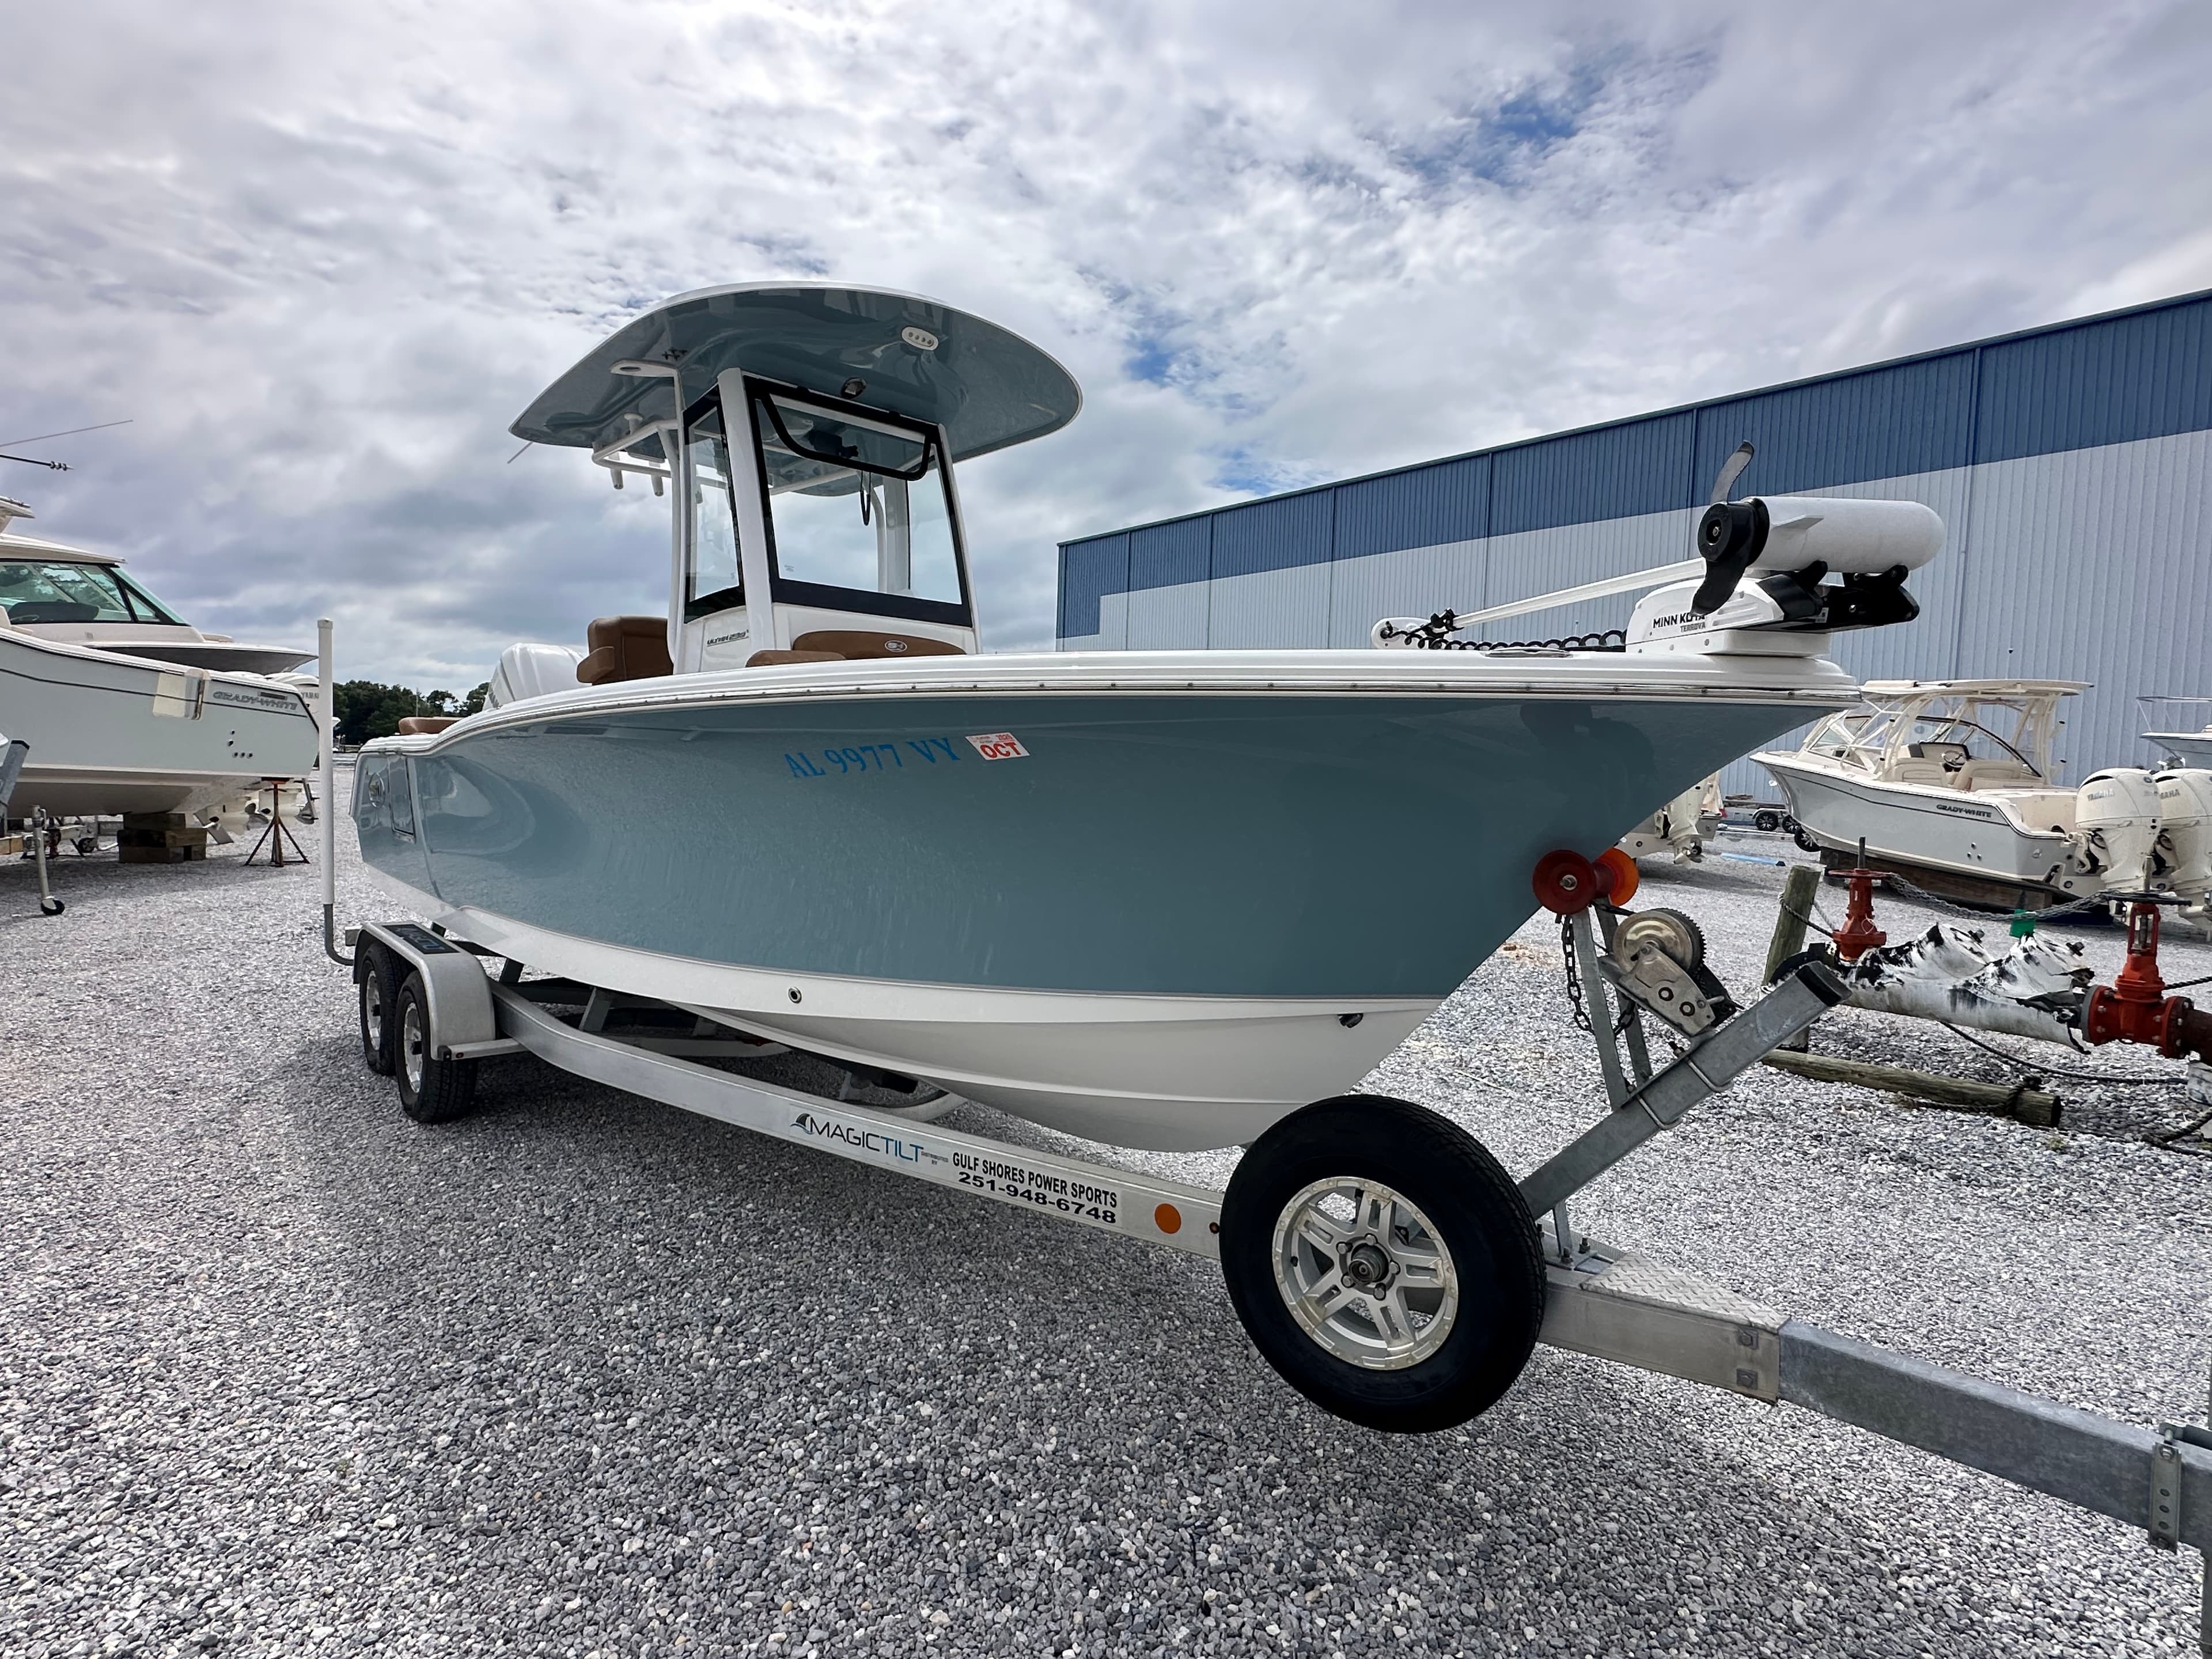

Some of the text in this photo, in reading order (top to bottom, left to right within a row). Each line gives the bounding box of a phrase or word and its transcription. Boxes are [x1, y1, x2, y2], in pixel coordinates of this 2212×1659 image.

[1652, 613, 1678, 628] MINN
[213, 691, 298, 710] GRADY-WHITE
[784, 737, 960, 778] AL 9977 VY
[980, 742, 1021, 759] OCT
[1936, 804, 1992, 818] GRADY-WHITE
[810, 1116, 924, 1162] MAGICTILT
[952, 1152, 1118, 1209] GULF SHORES POWER SPORTS
[958, 1171, 1116, 1224] 251-948-6748
